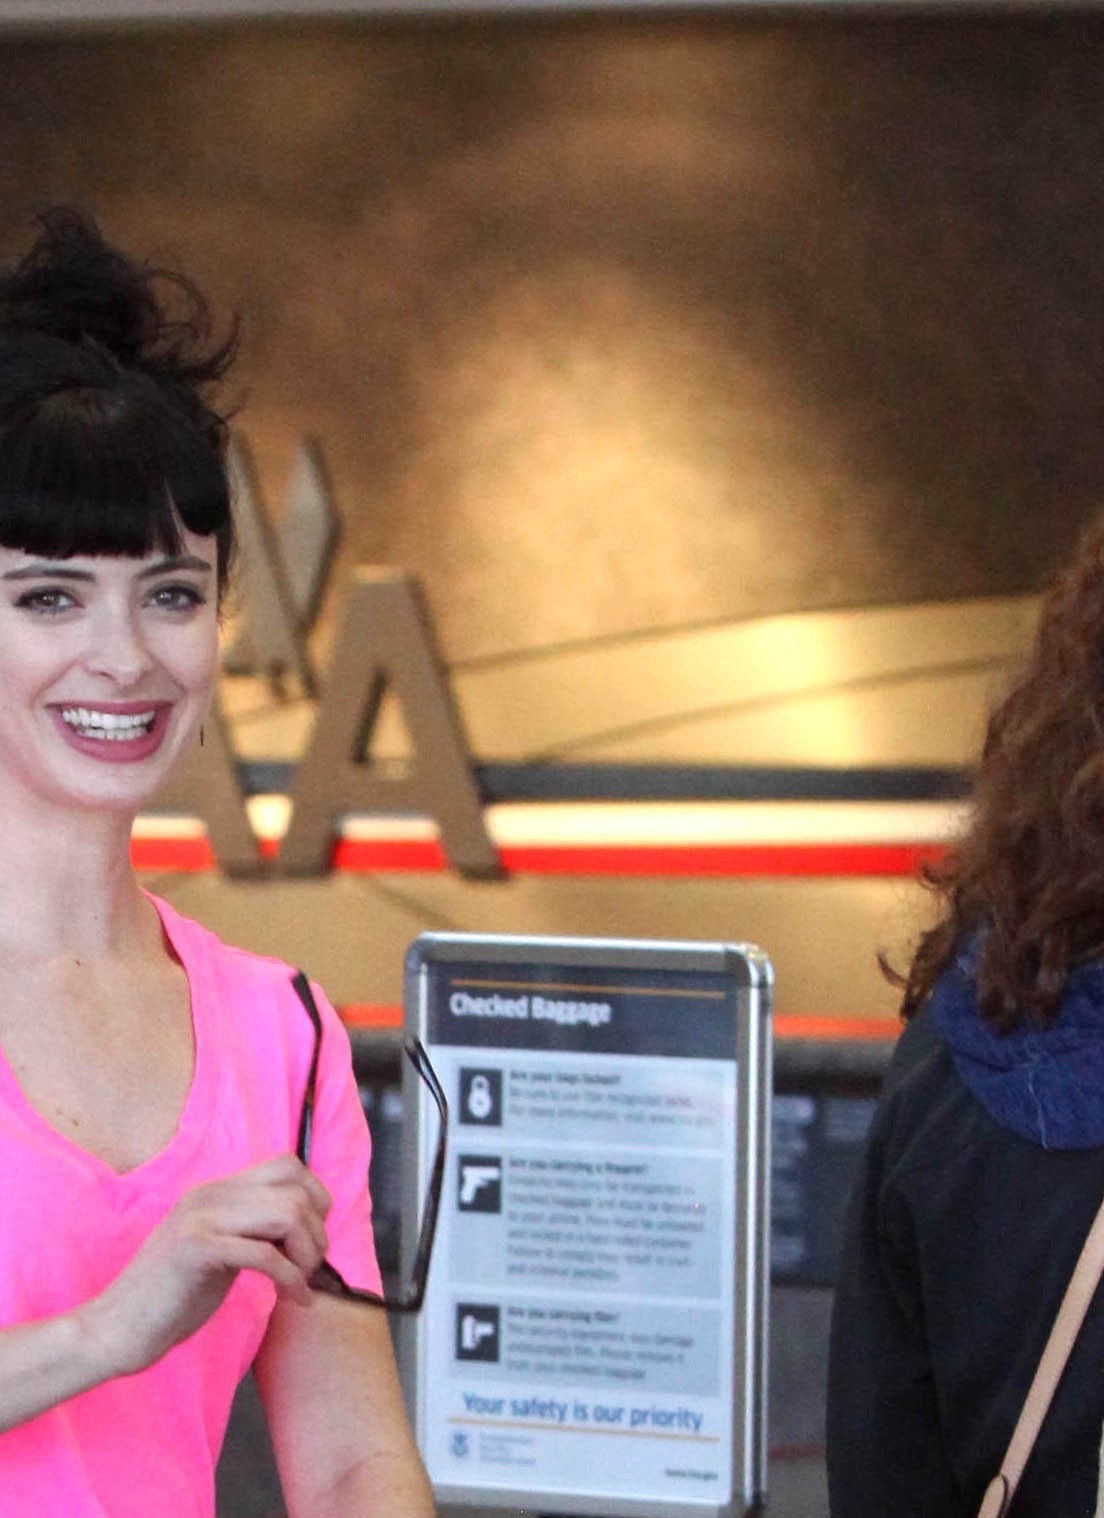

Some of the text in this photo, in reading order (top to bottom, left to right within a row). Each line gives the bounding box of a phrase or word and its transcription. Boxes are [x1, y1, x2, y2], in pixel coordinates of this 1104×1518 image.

[449, 992, 611, 1027] Checked Baggage
[463, 1391, 704, 1432] Your safety is our priority
